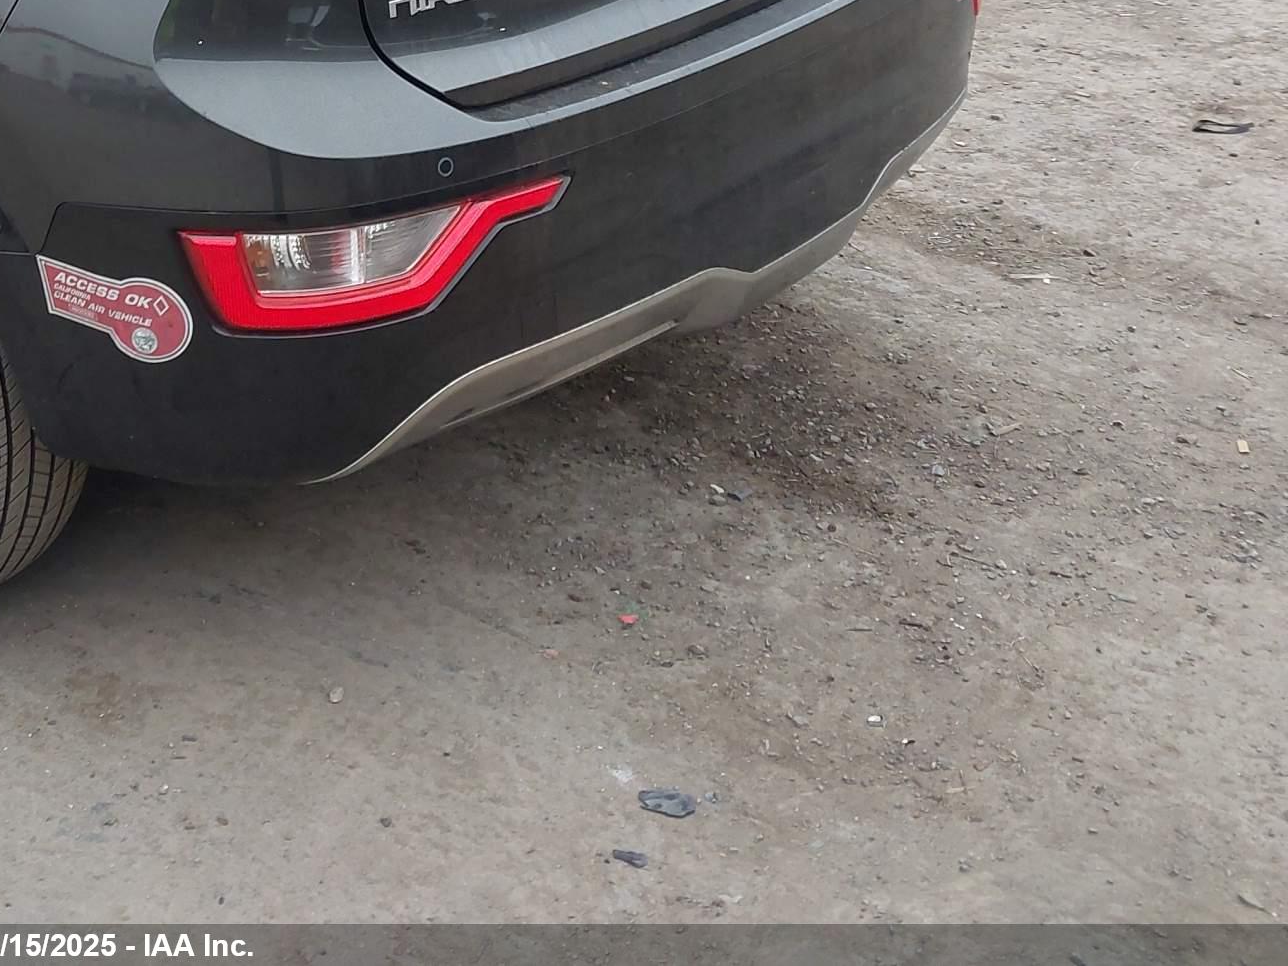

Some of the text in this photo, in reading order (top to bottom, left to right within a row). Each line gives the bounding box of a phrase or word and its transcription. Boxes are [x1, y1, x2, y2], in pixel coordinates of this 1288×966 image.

[54, 271, 153, 309] ACCESS OK
[54, 283, 91, 301] CALIFORNIA
[54, 290, 87, 308] CLEAN
[88, 302, 105, 315] AIR
[108, 309, 153, 327] VEHICLE
